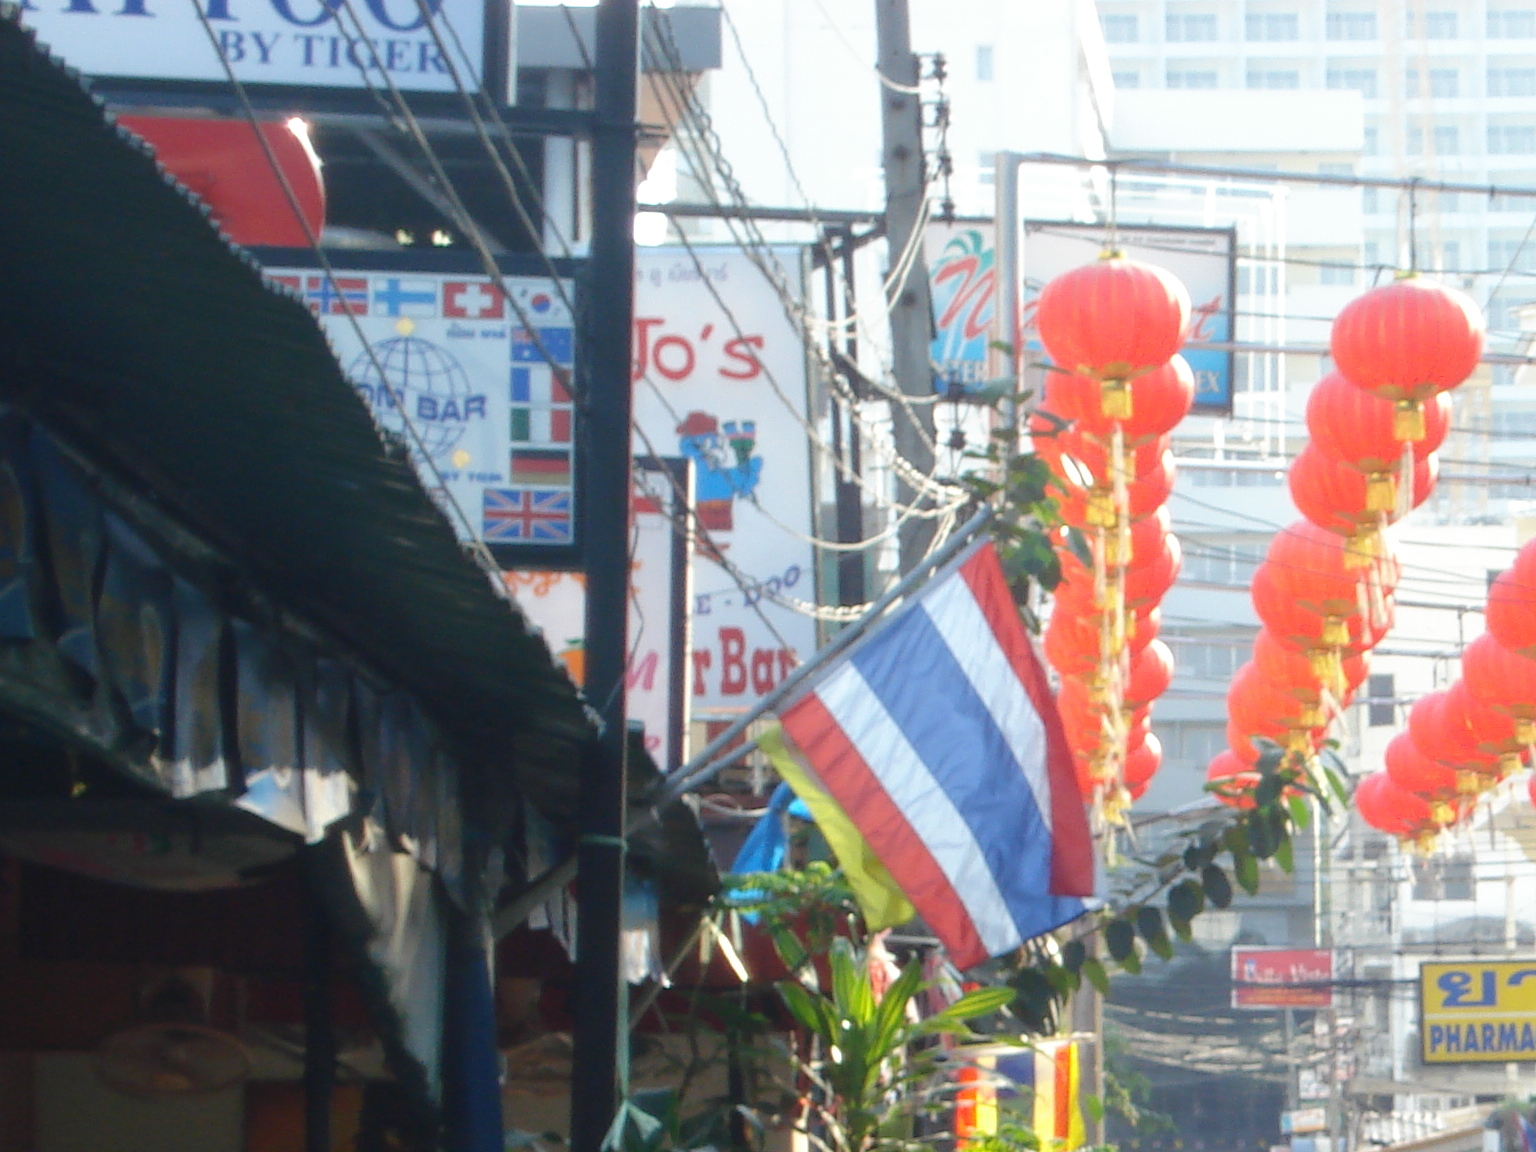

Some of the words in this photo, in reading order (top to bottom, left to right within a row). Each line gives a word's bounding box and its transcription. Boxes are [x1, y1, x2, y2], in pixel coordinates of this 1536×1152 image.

[220, 29, 281, 64] BY
[304, 34, 449, 74] TIGER
[417, 395, 486, 422] BAR
